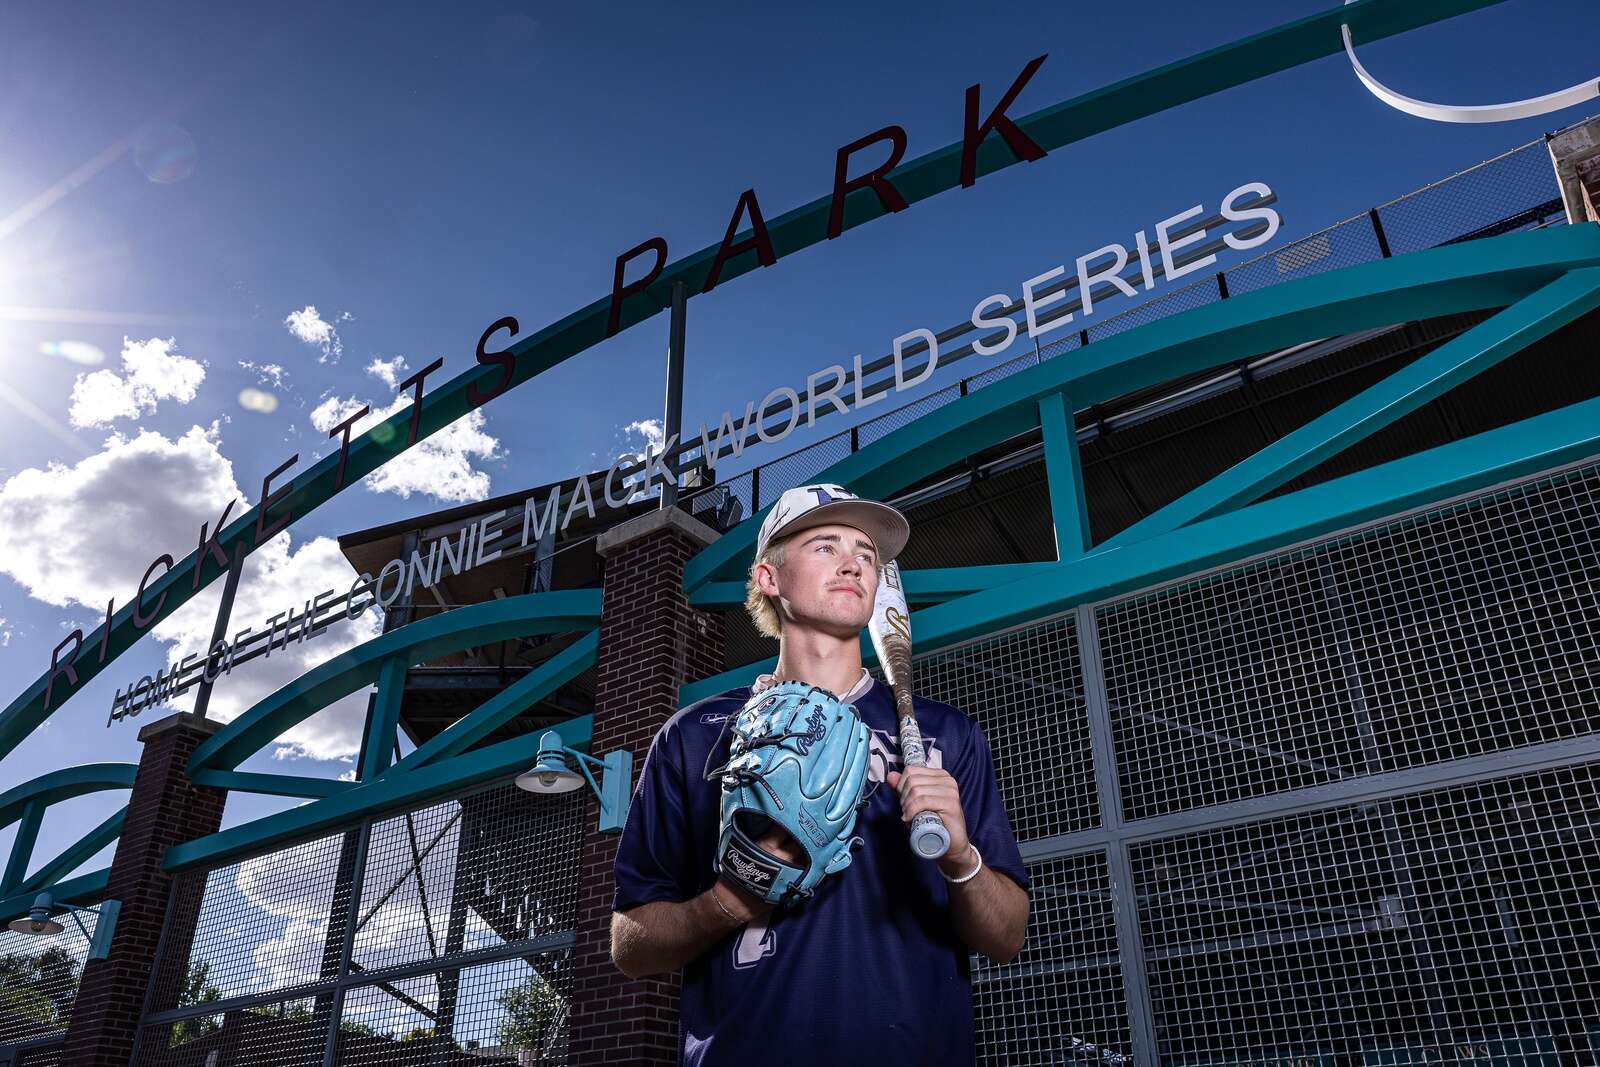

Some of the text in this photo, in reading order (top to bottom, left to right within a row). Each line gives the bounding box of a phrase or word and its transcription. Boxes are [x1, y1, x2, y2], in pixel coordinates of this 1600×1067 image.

[43, 53, 1048, 712] RICKETTS PARK
[106, 182, 1281, 727] HOME OF THE CONNIE MACK WORLD SERIES
[727, 848, 771, 883] Rawlings
[796, 704, 824, 757] Rawlings
